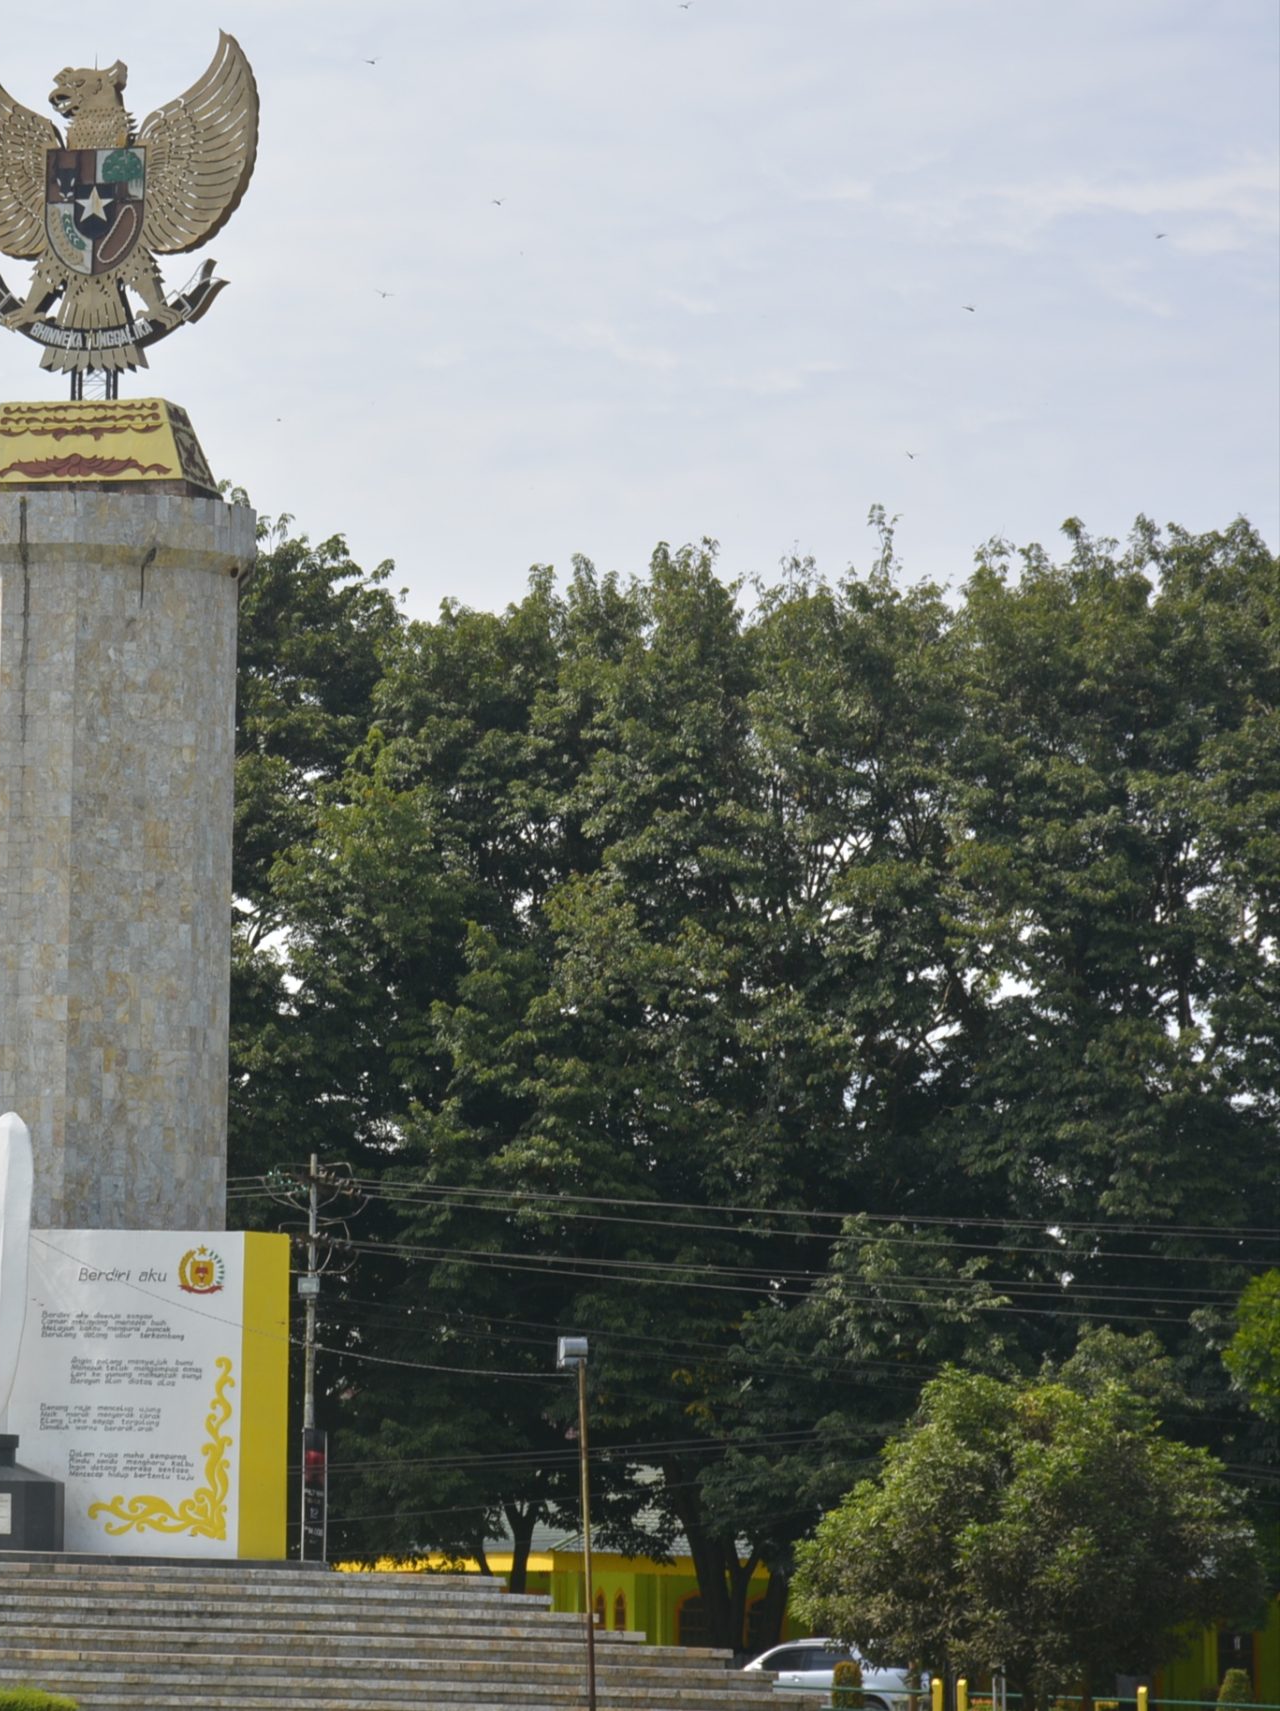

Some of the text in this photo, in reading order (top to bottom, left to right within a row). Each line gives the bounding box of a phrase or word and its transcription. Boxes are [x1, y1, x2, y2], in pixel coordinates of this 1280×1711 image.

[30, 320, 154, 348] BHINNEKA TUNGGAL IKA
[79, 1267, 168, 1282] Berdiri aku
